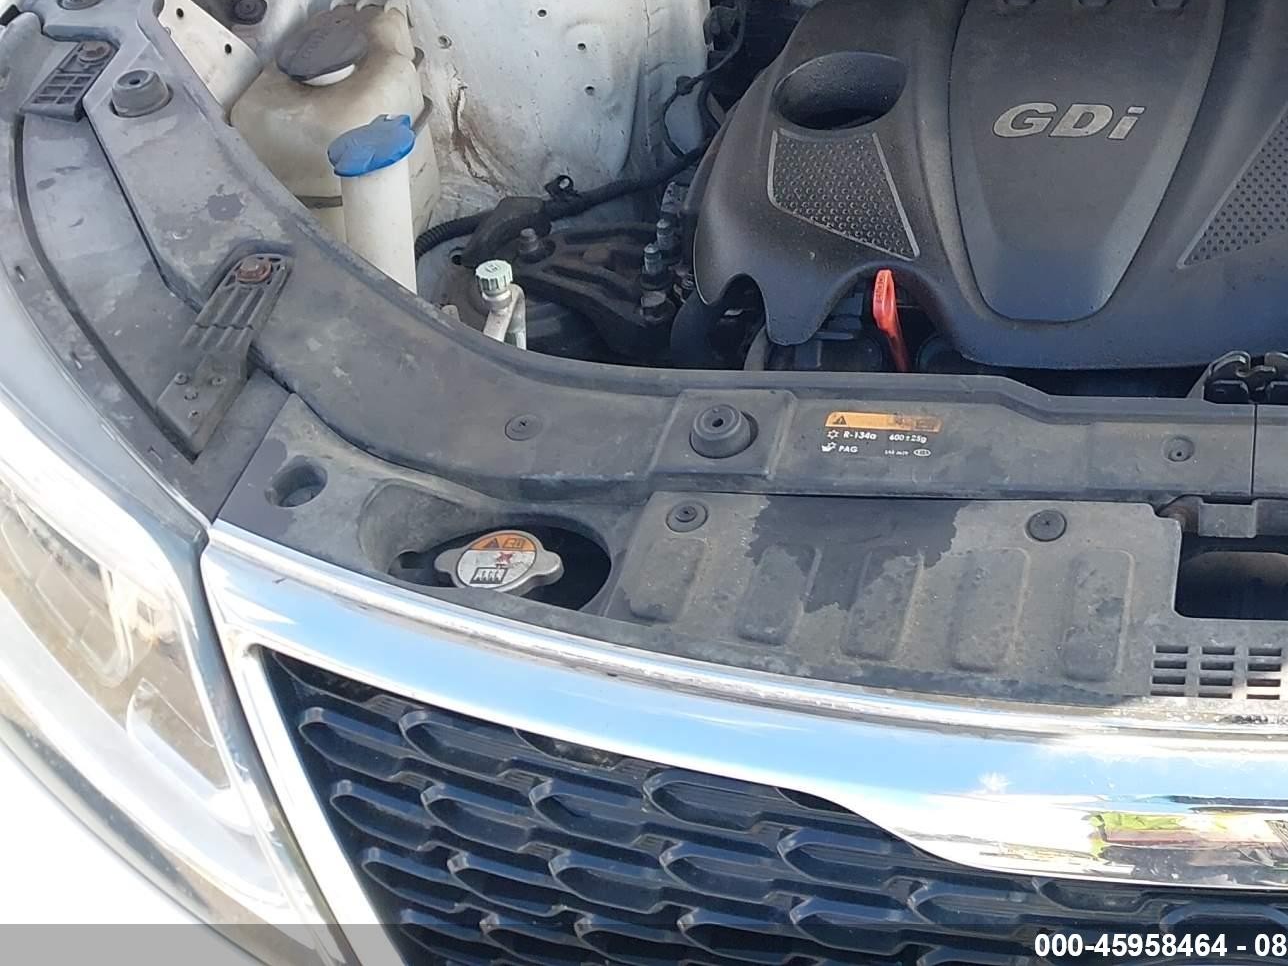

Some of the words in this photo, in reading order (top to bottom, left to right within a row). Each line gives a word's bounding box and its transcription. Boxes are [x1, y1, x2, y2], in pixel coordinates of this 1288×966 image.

[992, 101, 1147, 141] GDi
[843, 431, 878, 440] R-134a
[838, 445, 859, 453] PAG
